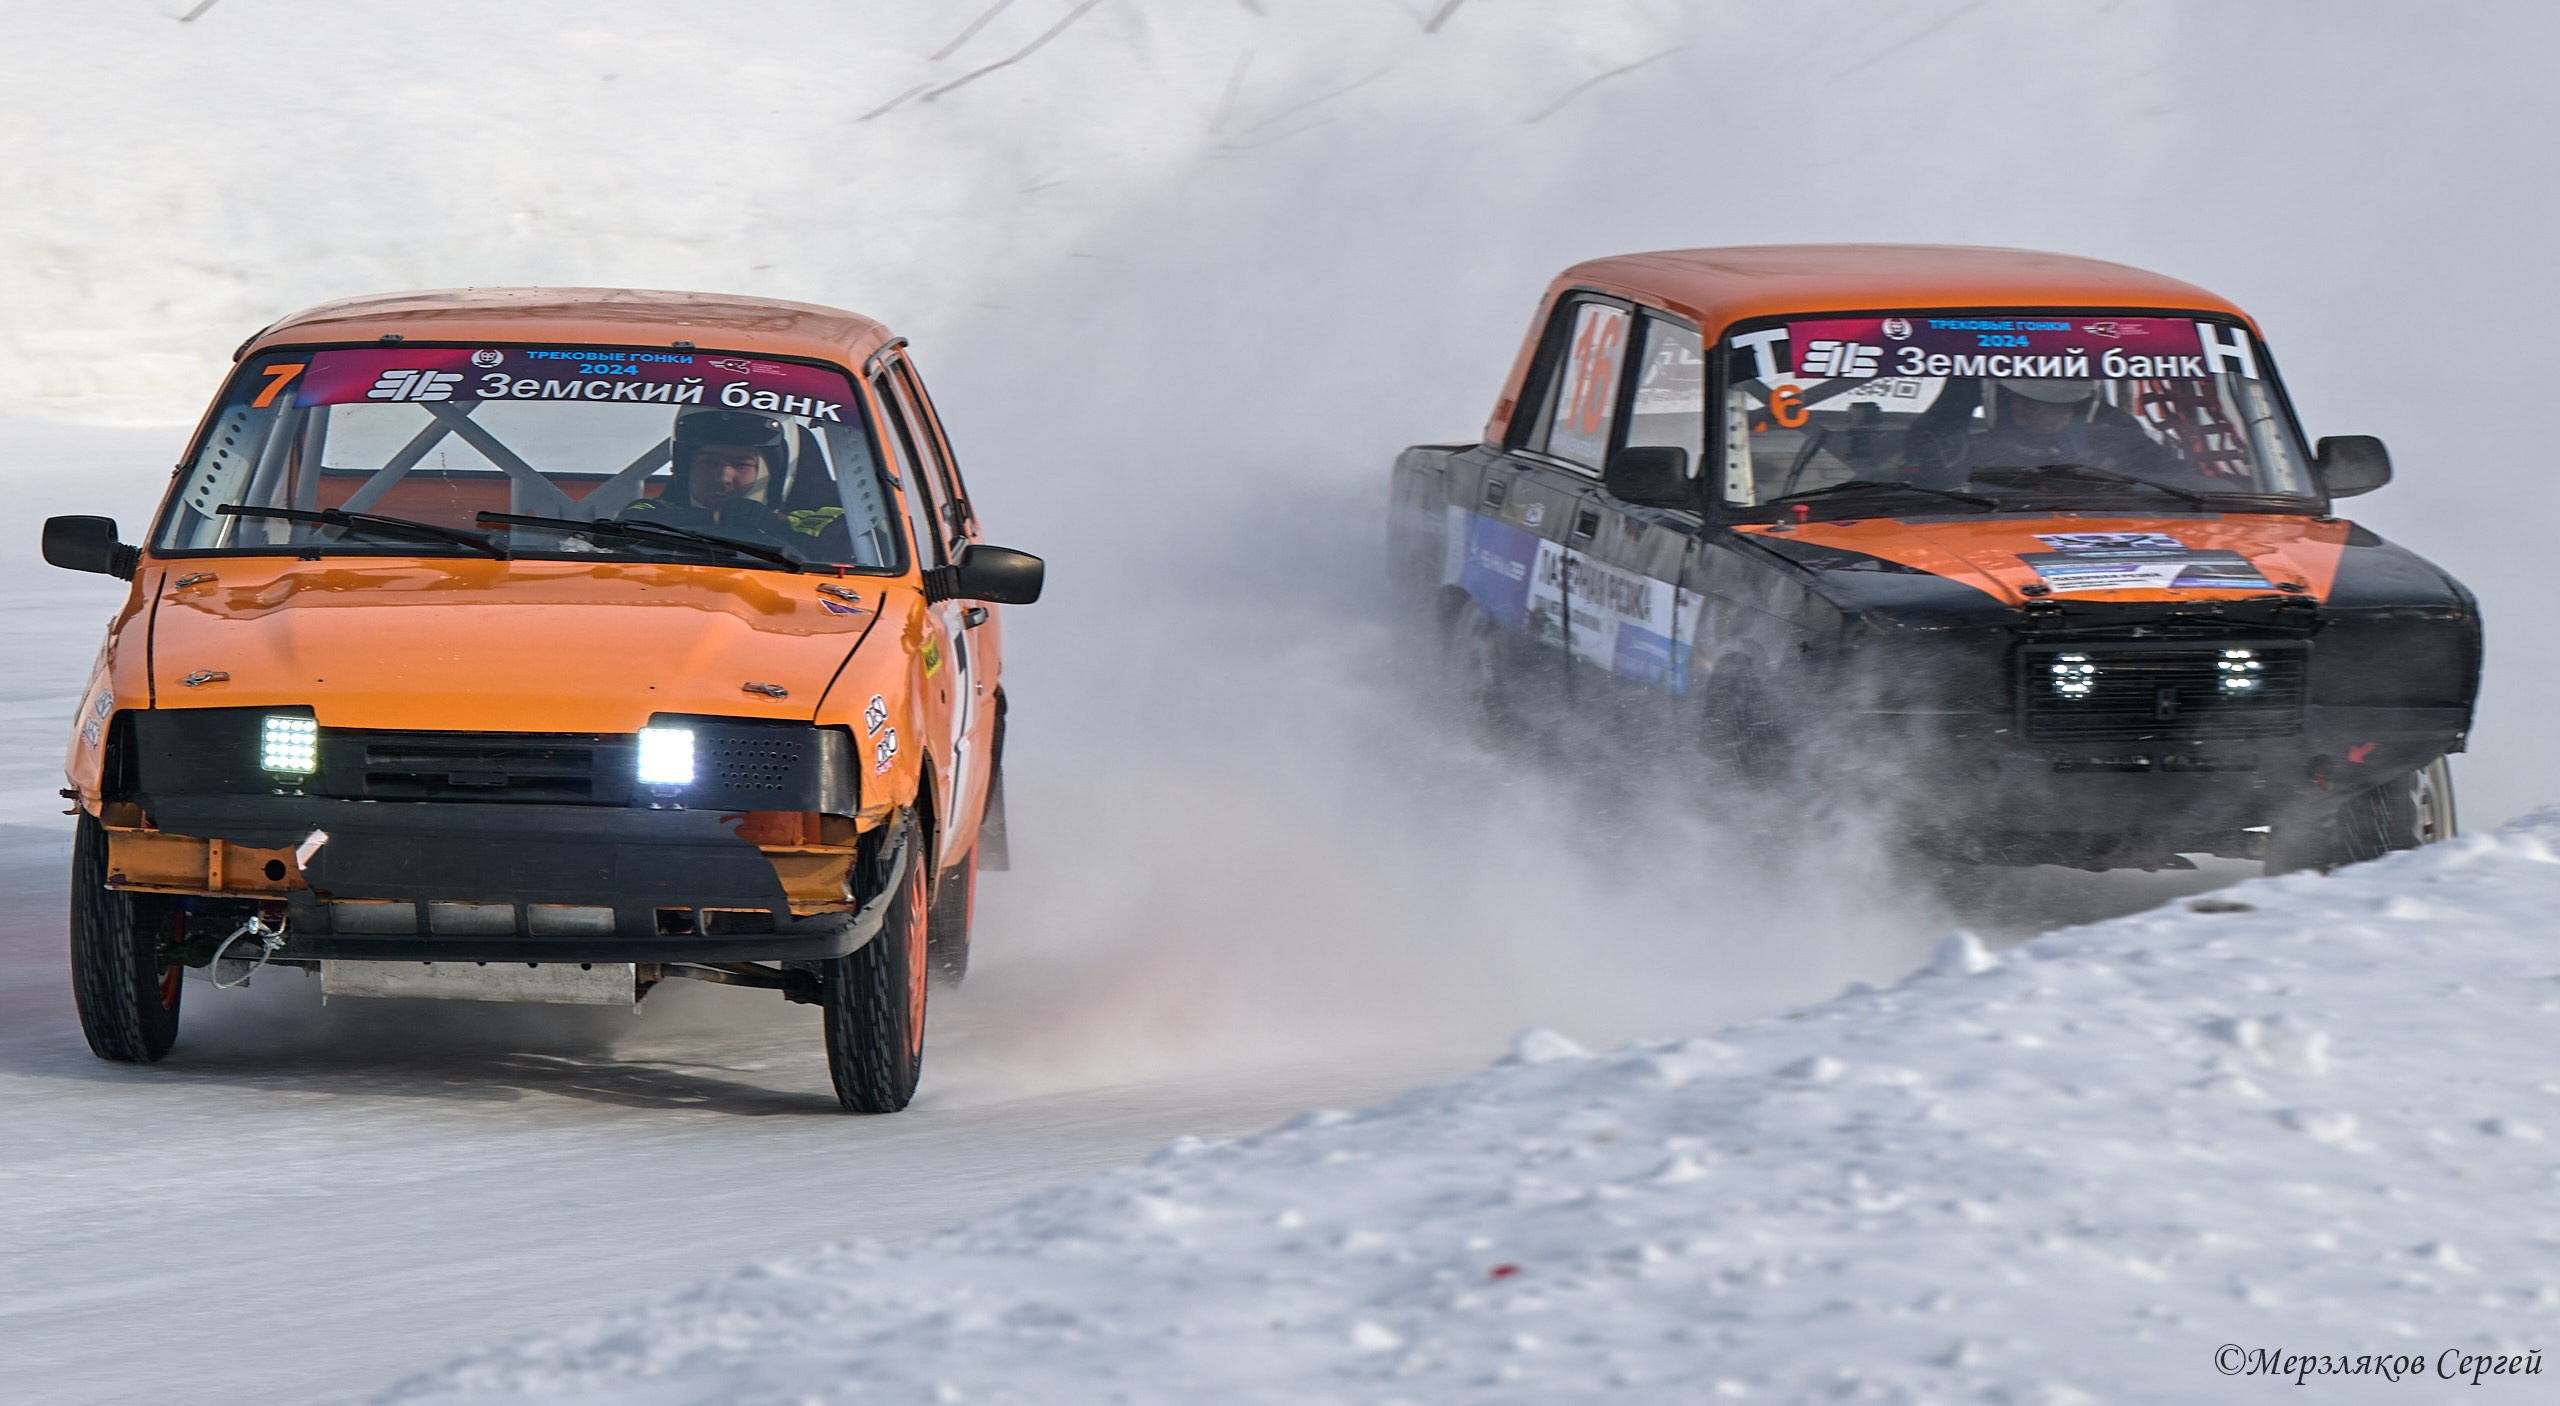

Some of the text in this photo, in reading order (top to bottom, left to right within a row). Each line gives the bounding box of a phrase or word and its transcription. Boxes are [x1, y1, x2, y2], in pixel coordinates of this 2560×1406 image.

[1928, 319, 2071, 331] ТРЕКОВЫЕ ГОНКИ
[1977, 334, 2029, 347] 2024
[527, 351, 693, 364] ТРЕКОВЫЕ ГОНКИ
[1895, 346, 2089, 377] Земский
[2102, 347, 2206, 377] банк
[579, 363, 639, 376] 2024
[1567, 310, 1621, 436] 16
[252, 363, 306, 408] 7
[475, 373, 704, 405] Земский
[719, 381, 842, 423] банк
